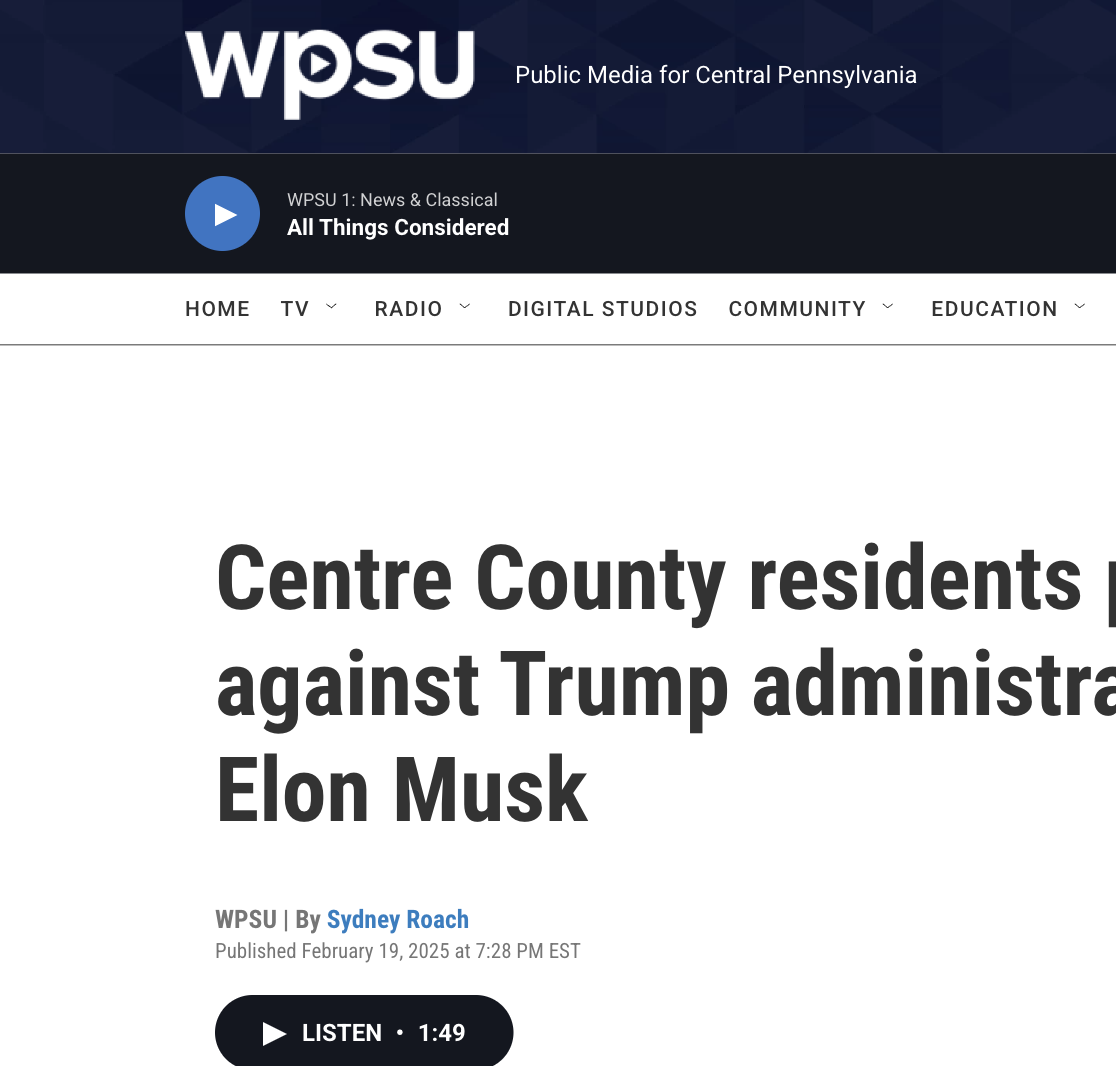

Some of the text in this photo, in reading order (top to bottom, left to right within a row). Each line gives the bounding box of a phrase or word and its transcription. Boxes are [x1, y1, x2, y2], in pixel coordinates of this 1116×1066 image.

[517, 64, 916, 88] Public Media for Central Pennsylvania
[287, 192, 497, 206] WPSU 1: News & Classical
[287, 218, 509, 240] All Things Considered
[186, 301, 249, 316] HOME
[281, 301, 309, 316] TV
[376, 301, 441, 316] RADIO
[509, 301, 696, 316] DIGITAL STUDIOS
[729, 301, 865, 316] COMMUNITY
[932, 301, 1056, 316] EDUCATION
[219, 544, 451, 610] Centre
[478, 544, 726, 628] County
[752, 541, 1080, 610] residents
[218, 648, 479, 734] against
[500, 651, 727, 734] Trump
[220, 753, 588, 822] Elon Musk
[215, 909, 468, 934] WPSU By Sydney Roach
[216, 942, 581, 963] Published February 19, 2025 at 7:28 PM EST
[303, 1023, 465, 1042] LISTEN 1:49
